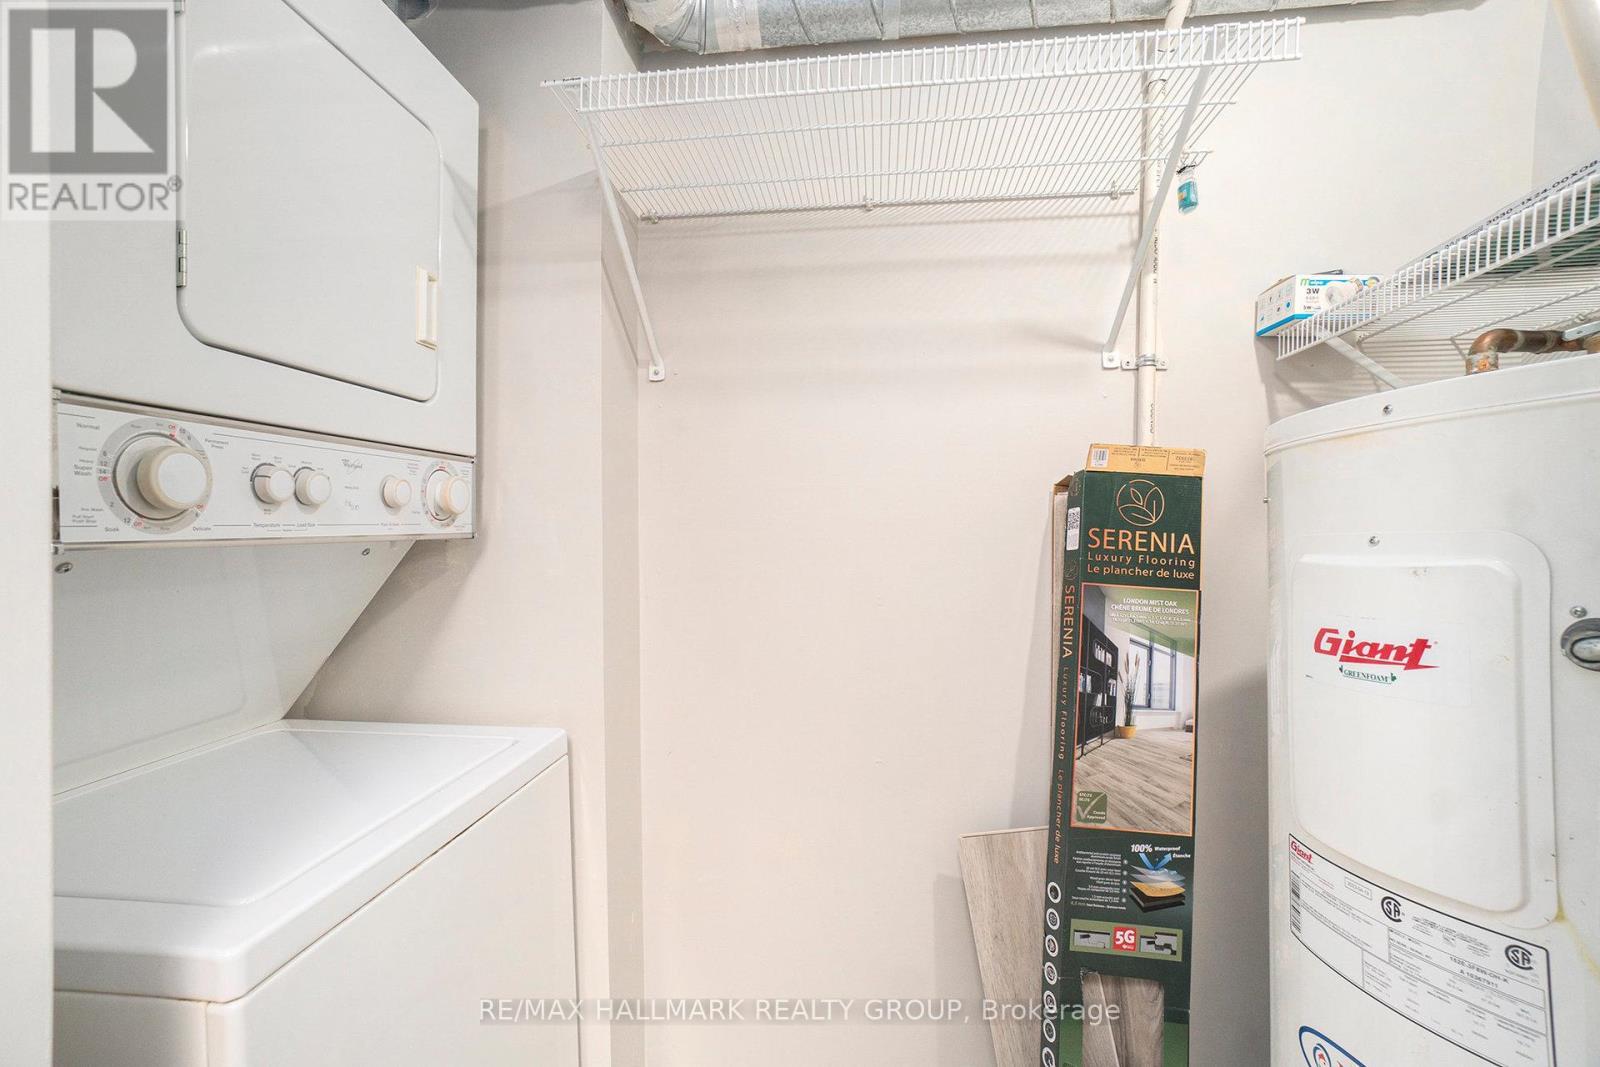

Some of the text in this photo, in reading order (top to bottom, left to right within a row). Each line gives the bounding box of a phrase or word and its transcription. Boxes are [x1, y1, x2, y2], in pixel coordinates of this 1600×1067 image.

[1088, 528, 1195, 554] SERENIA
[1087, 564, 1195, 579] Le plancher de luxe
[1088, 551, 1196, 569] Luxury Flooring
[1062, 585, 1075, 658] SERENIA
[1314, 627, 1436, 670] Giant
[1060, 666, 1069, 706] Luxury
[1131, 844, 1181, 853] 100% Waterproof
[1291, 840, 1313, 864] Giant
[1115, 930, 1135, 944] 5G
